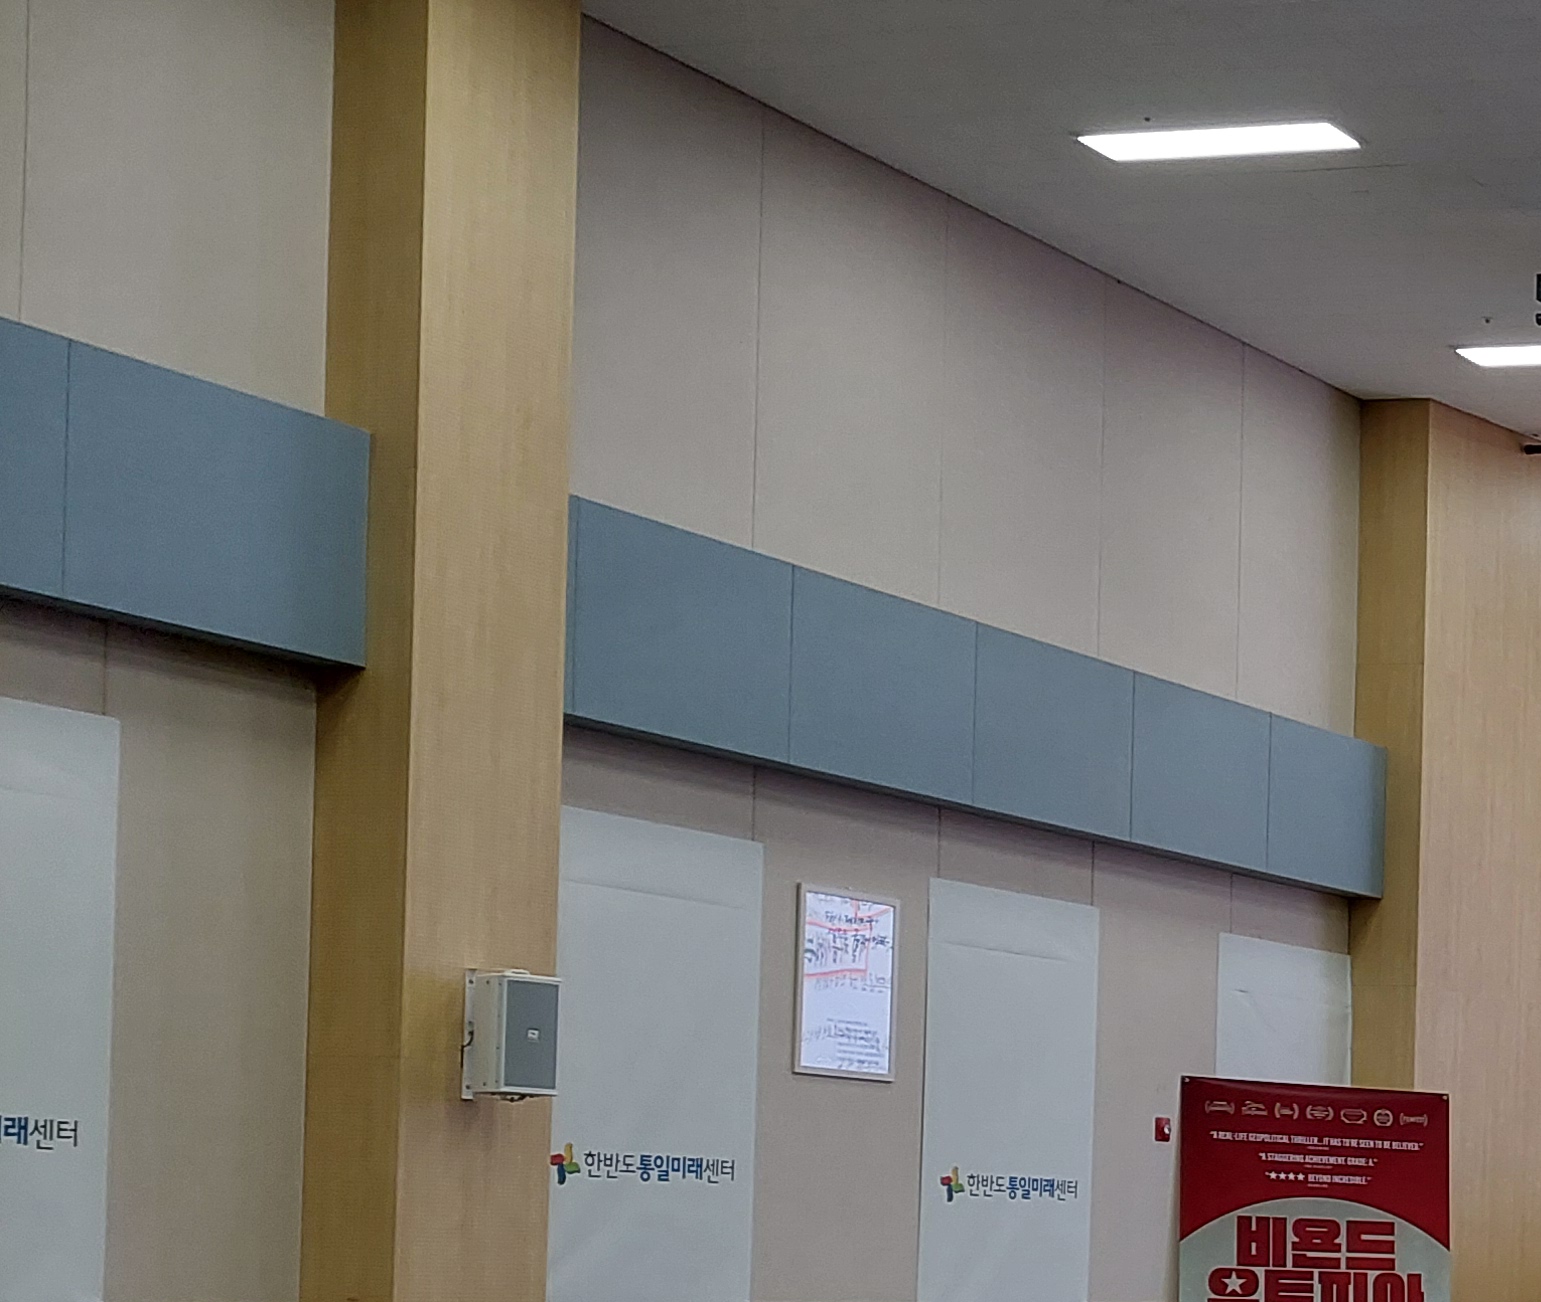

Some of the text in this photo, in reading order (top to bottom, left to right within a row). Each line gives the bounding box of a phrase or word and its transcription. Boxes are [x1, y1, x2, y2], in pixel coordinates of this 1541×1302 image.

[0, 1115, 79, 1151] 래센터
[584, 1151, 736, 1184] 한반도통일미래센터
[966, 1173, 1078, 1202] 한반도통일미래센터
[1236, 1214, 1396, 1271] 비욘드
